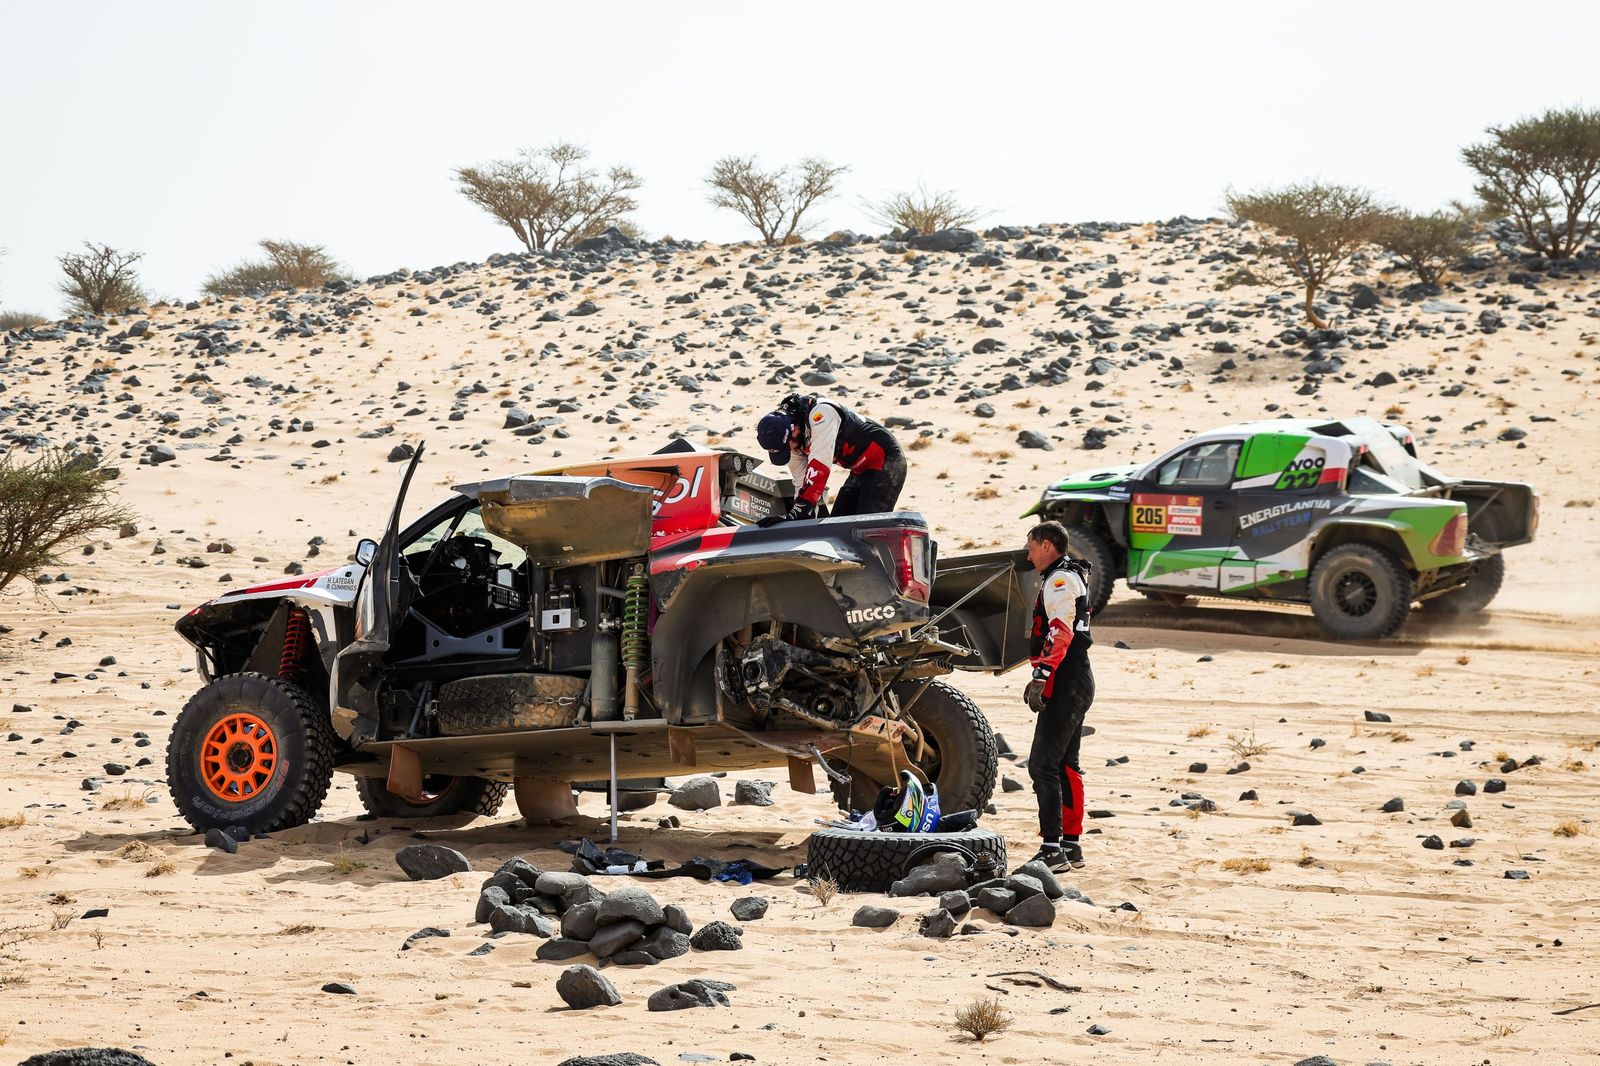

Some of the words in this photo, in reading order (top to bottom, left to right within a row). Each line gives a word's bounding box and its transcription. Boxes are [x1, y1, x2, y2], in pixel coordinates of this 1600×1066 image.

[732, 497, 750, 513] GR
[750, 495, 771, 508] TOYOTA
[750, 502, 770, 514] GAZOO
[1136, 507, 1162, 525] 205
[1239, 499, 1331, 529] ENERGYLANDIA
[332, 577, 354, 585] LATEGAN
[920, 813, 934, 832] US
